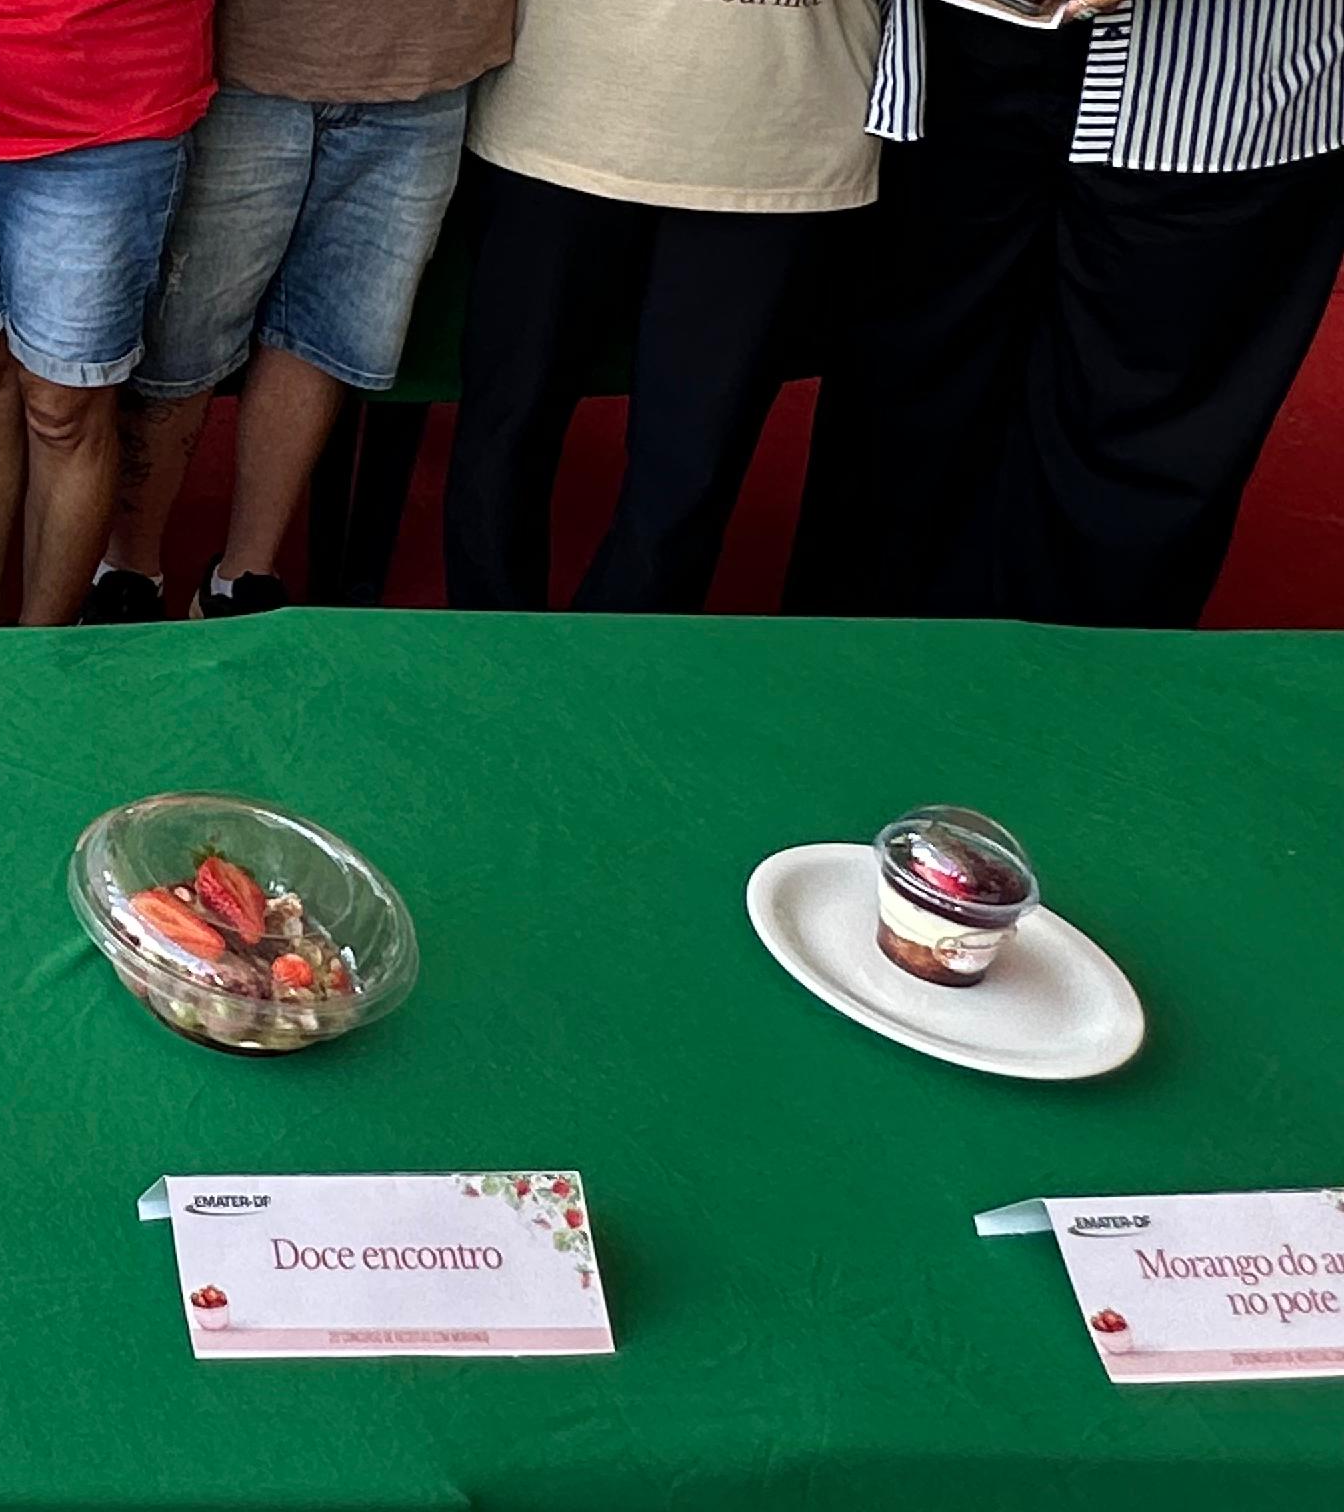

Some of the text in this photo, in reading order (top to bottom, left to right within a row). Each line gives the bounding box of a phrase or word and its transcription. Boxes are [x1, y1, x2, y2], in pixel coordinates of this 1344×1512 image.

[270, 1238, 503, 1271] Doce encontro
[1134, 1248, 1274, 1286] Morango
[1278, 1243, 1318, 1277] do
[1227, 1287, 1340, 1323] no pote
